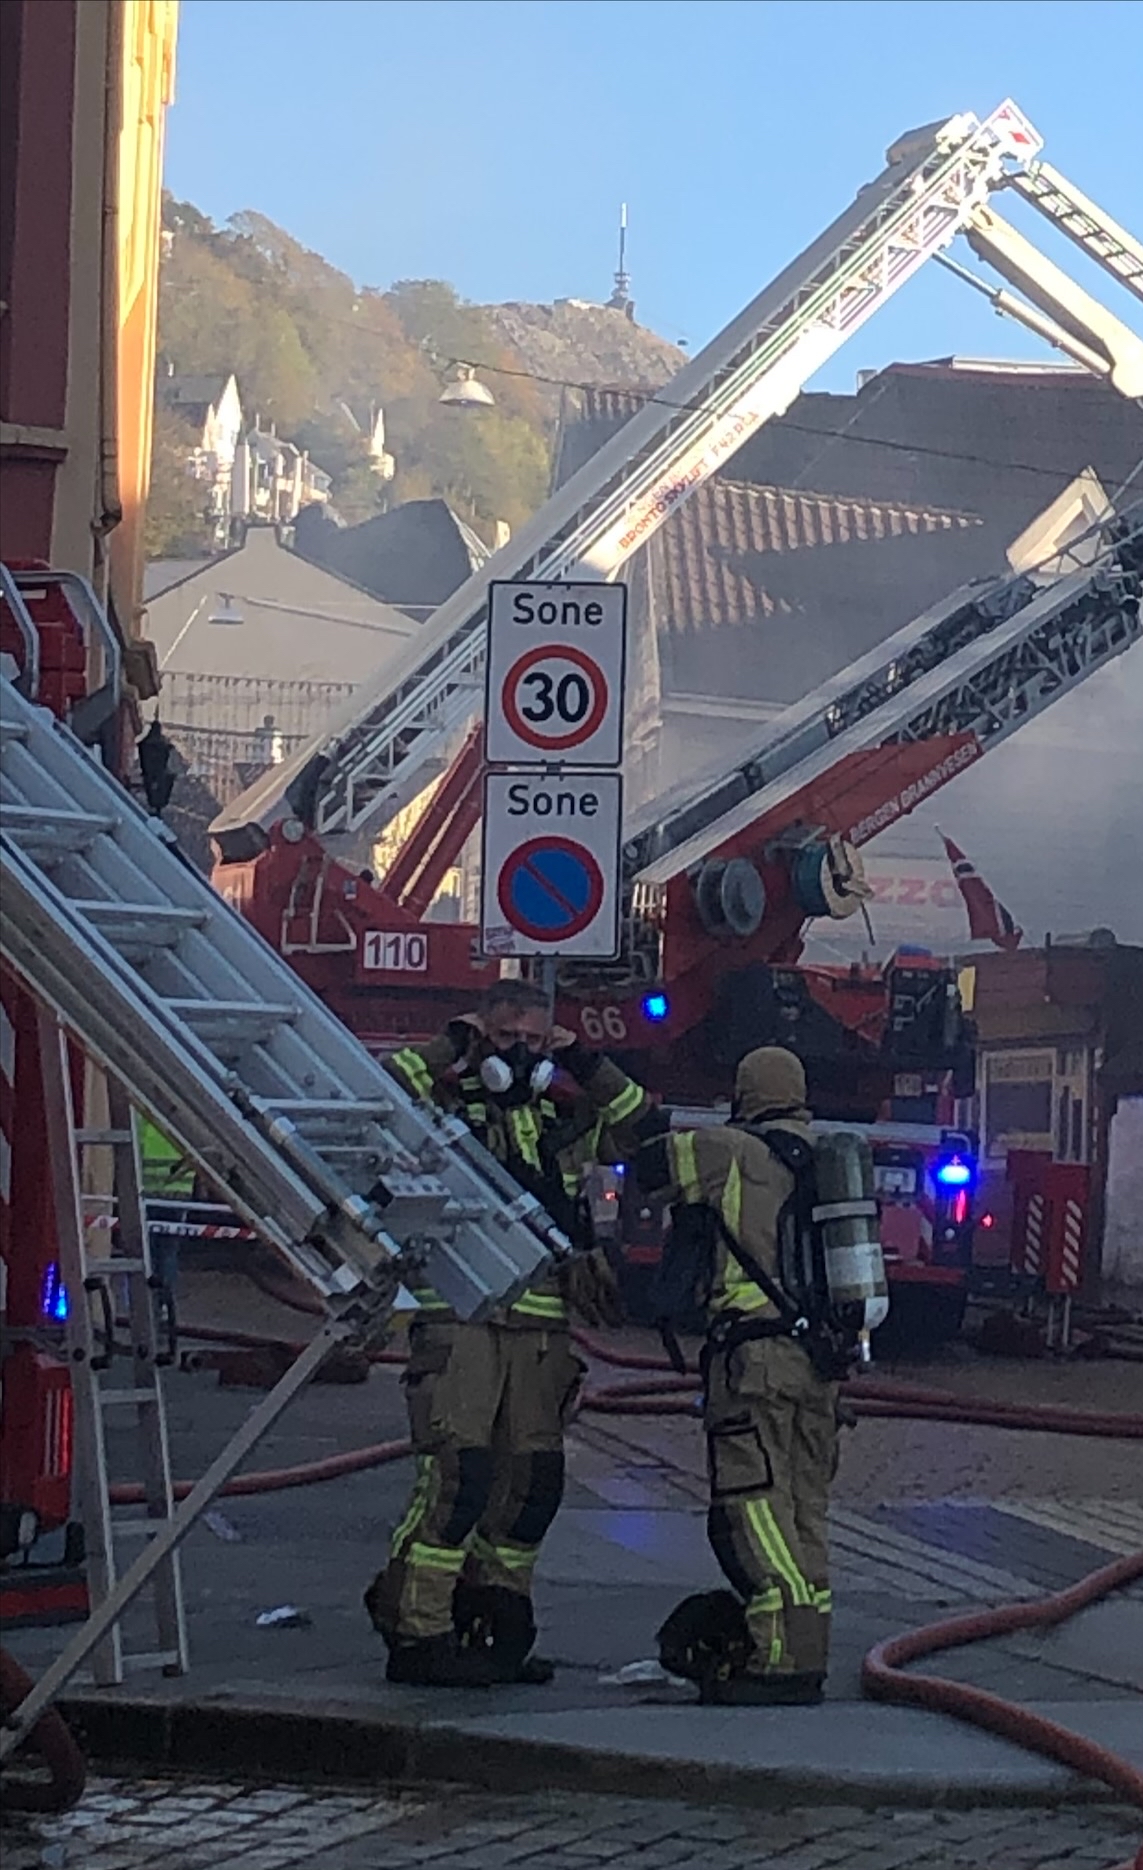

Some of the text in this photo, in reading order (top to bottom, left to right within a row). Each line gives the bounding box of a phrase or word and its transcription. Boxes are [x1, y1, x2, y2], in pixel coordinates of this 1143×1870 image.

[513, 592, 603, 626] Sone
[522, 672, 590, 723] 30
[507, 784, 599, 817] Sone
[366, 934, 426, 969] 110
[580, 1006, 627, 1040] 66
